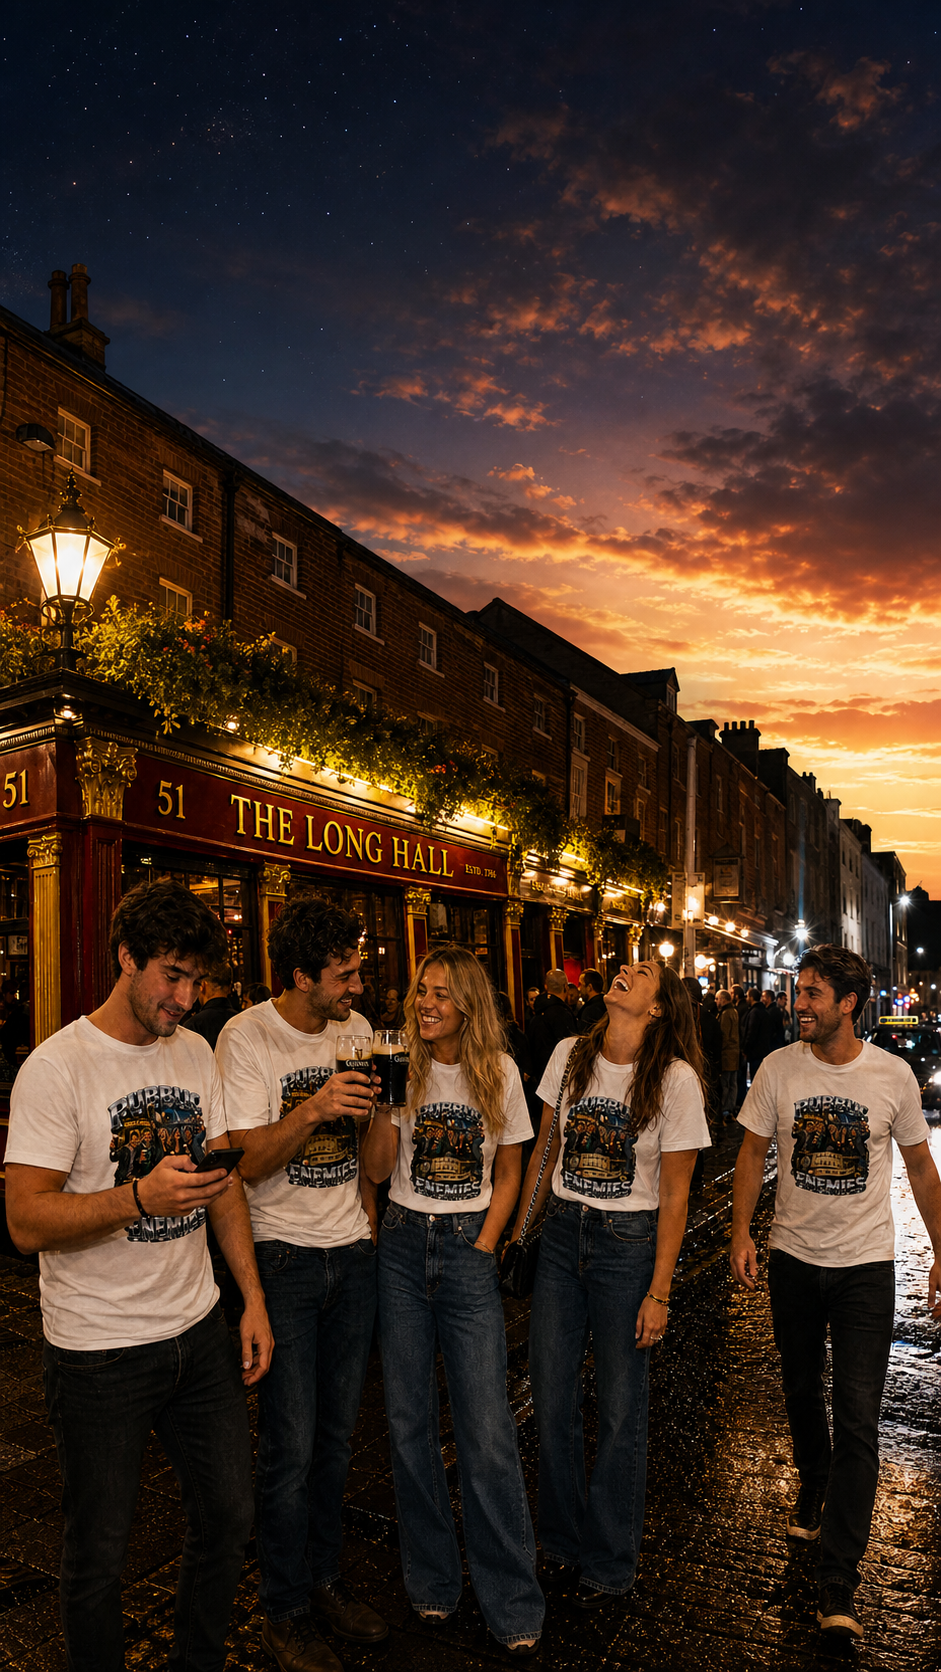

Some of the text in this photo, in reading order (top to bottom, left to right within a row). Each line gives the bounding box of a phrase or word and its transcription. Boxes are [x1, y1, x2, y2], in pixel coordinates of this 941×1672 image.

[3, 769, 29, 808] 51
[158, 780, 186, 819] 51
[231, 794, 454, 877] THE LONG HALL
[414, 1176, 481, 1199] ENEMIES
[563, 1171, 632, 1197] ENEMIES
[795, 1170, 866, 1194] ENEMIES
